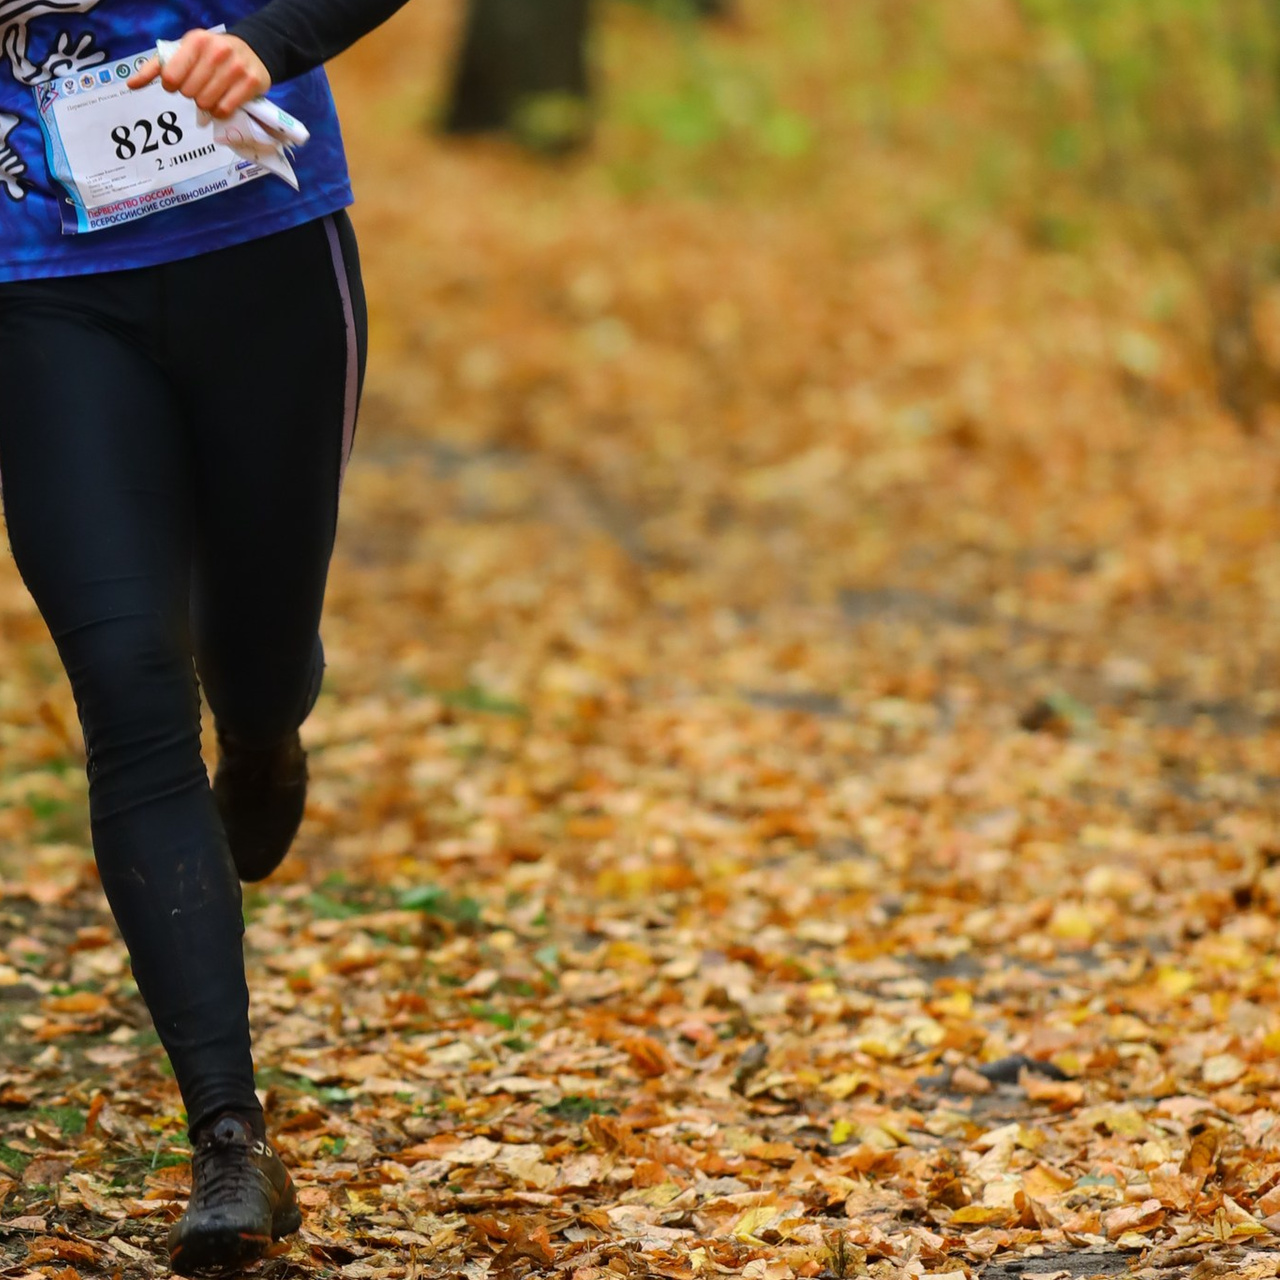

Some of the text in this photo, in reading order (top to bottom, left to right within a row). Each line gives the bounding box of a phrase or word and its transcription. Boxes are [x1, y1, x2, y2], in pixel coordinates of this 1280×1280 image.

[110, 109, 184, 161] 828
[154, 157, 165, 171] 2
[168, 143, 216, 167] линия
[87, 198, 139, 219] ПЕРВЕНСТВО
[139, 186, 175, 205] РОССИИ
[159, 179, 229, 208] СОРЕВНОВАНИЯ
